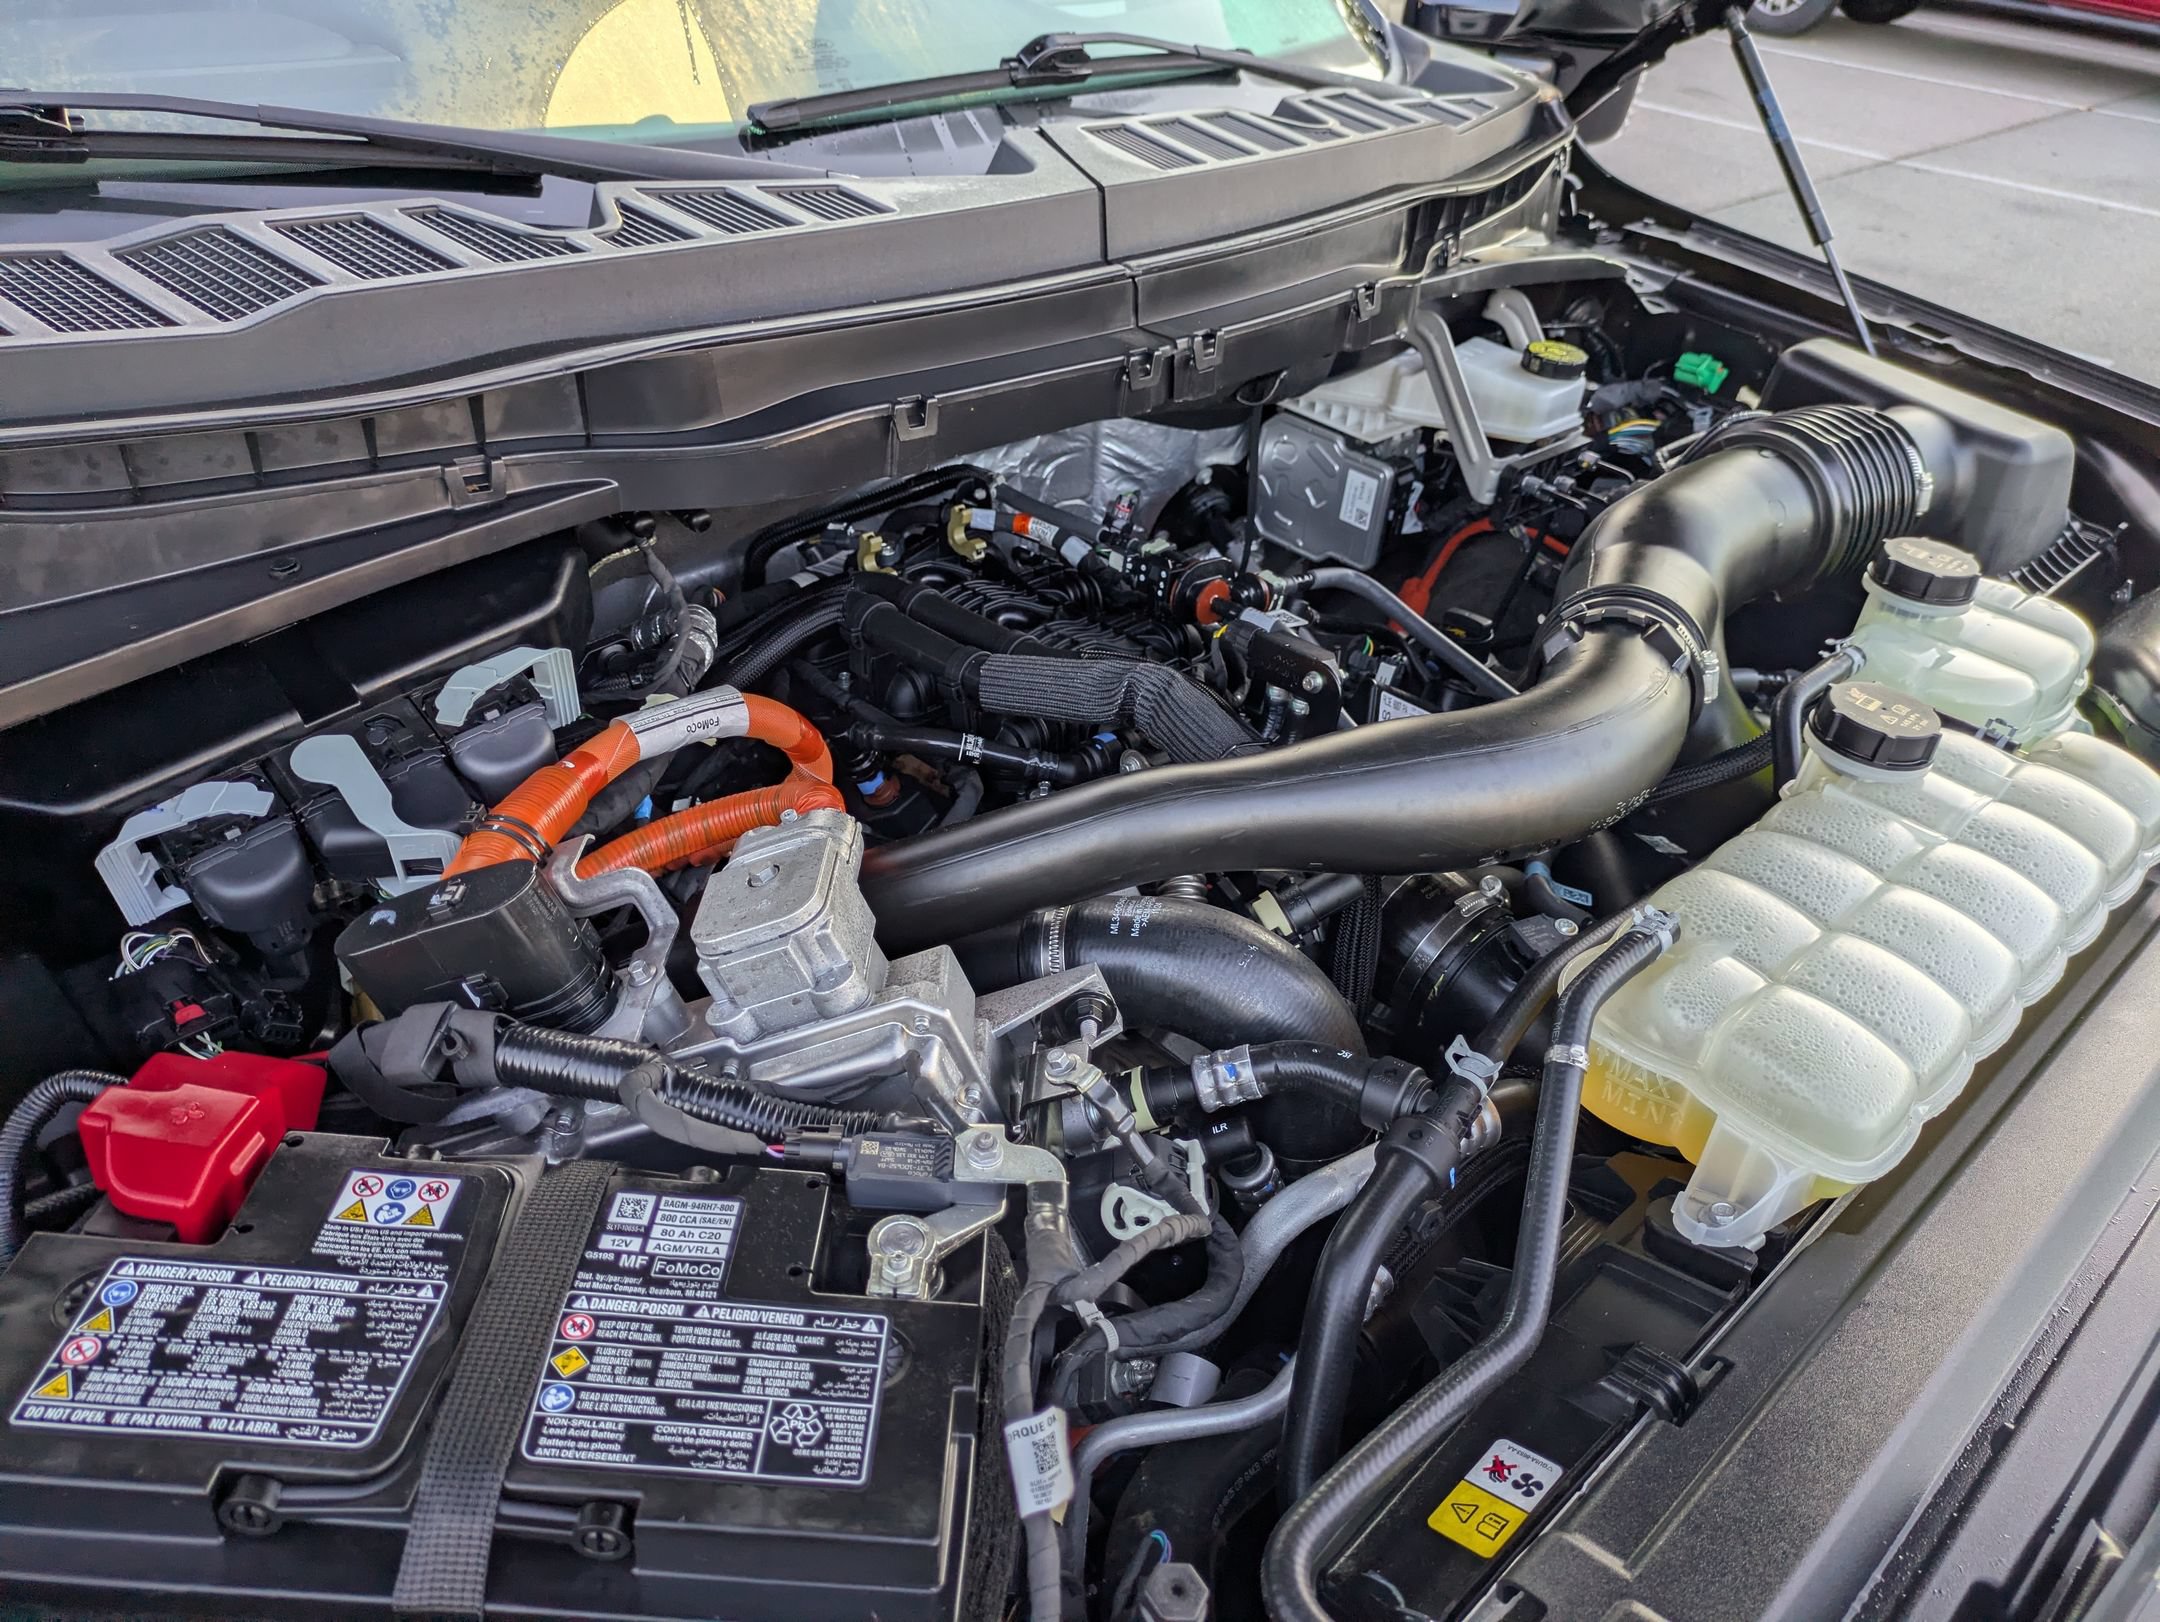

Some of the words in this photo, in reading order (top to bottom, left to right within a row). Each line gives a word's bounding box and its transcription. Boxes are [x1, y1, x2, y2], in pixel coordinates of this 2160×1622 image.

[686, 716, 720, 733] FoMoCo
[1610, 1054, 1670, 1099] MAX
[1602, 1080, 1666, 1124] MIN
[1212, 1122, 1228, 1134] ILR
[660, 1213, 677, 1223] 800
[679, 1214, 697, 1224] CCA
[699, 1216, 732, 1226] (SAE/EN)
[660, 1229, 675, 1238] 80
[678, 1229, 695, 1238] Ah
[698, 1230, 721, 1240] C20
[610, 1238, 633, 1248] 12V
[654, 1243, 720, 1255] AGM/VRLA
[619, 1254, 649, 1269] MF
[135, 1264, 235, 1281] DANGER/POISON
[655, 1261, 720, 1276] FoMoCo
[260, 1274, 359, 1291] PELIGRO/VENENO
[574, 1281, 591, 1289] Ford
[592, 1282, 612, 1290] Motor
[143, 1284, 172, 1293] SHIELD
[171, 1286, 197, 1295] EYES.
[138, 1293, 183, 1302] EXPLOSIVE
[293, 1295, 328, 1304] PROTEJA
[328, 1298, 345, 1306] LOS
[132, 1301, 161, 1309] GASES
[312, 1305, 329, 1313] LOS
[329, 1307, 356, 1315] GASES
[589, 1298, 684, 1315] DANGER/POISON
[197, 1306, 241, 1315] EXPLOSIFS
[240, 1309, 274, 1318] PEUVENT
[284, 1311, 334, 1322] EXPLOSIVOS
[711, 1308, 804, 1325] PELIGRO/VENENO
[598, 1320, 616, 1328] KEEP
[596, 1329, 618, 1337] REACH
[628, 1331, 663, 1341] CHILDREN.
[693, 1327, 711, 1335] HORS
[711, 1338, 741, 1347] ENFANTS.
[795, 1335, 824, 1344] ALCANCE
[596, 1347, 616, 1355] FLUSH
[616, 1348, 632, 1356] EYES
[663, 1352, 684, 1360] RINCEZ
[634, 1359, 652, 1367] WITH
[579, 1392, 600, 1400] READ
[601, 1393, 657, 1404] INSTRUCTIONS.
[576, 1401, 593, 1409] LIRE
[610, 1404, 667, 1415] INSTRUCTIONS.
[707, 1401, 765, 1412] INSTRUCCIONES.
[23, 1407, 44, 1418] DO
[43, 1408, 70, 1419] NOT
[69, 1410, 109, 1422] OPEN.
[111, 1413, 131, 1424] NE
[129, 1414, 155, 1425] PAS
[154, 1416, 205, 1429] OUVRIR.
[207, 1419, 227, 1430] NO
[227, 1421, 247, 1431] LA
[245, 1422, 283, 1434] ABRA.
[545, 1417, 625, 1429] NON-SPILLABLE
[789, 1420, 805, 1429] Pb
[541, 1426, 565, 1435] Lead
[567, 1428, 589, 1437] Acid
[590, 1430, 624, 1439] Battery
[654, 1426, 696, 1434] CONTRA
[698, 1429, 753, 1438] DERRAMES
[538, 1438, 575, 1447] Batterie
[590, 1441, 621, 1451] plomb
[695, 1437, 720, 1446] plomo
[535, 1448, 559, 1456] ANTI
